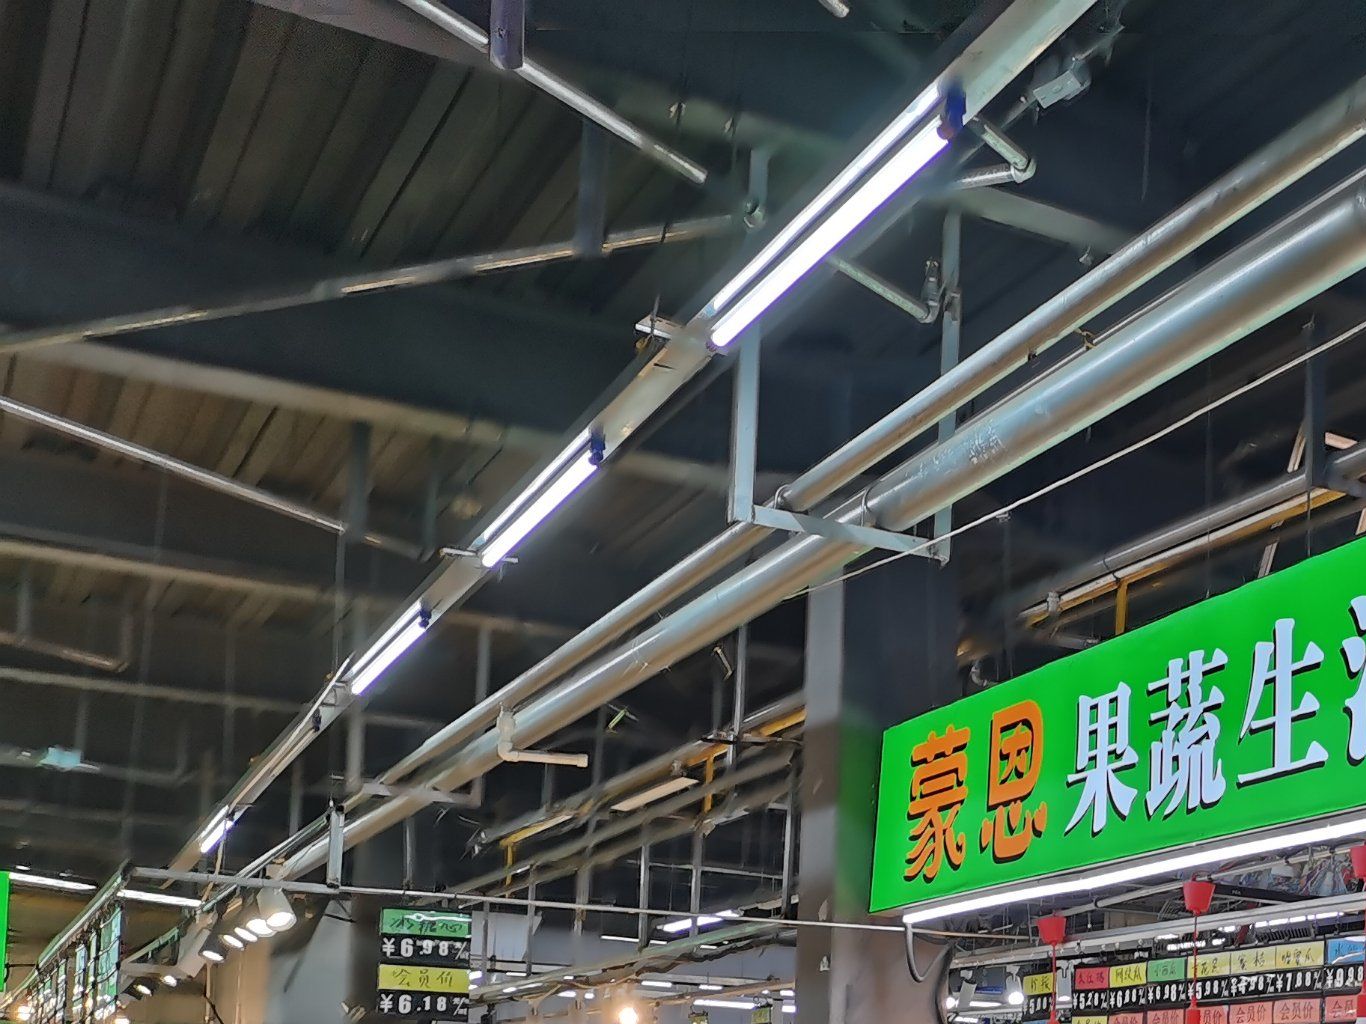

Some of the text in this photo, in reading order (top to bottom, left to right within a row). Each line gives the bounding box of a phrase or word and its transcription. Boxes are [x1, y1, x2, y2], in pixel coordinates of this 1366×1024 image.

[903, 699, 1049, 883] 蒙恩
[382, 938, 449, 957] ¥6.98
[393, 969, 453, 988] 会员价
[379, 994, 447, 1014] ¥6.18
[1280, 1002, 1313, 1020] 会员价
[1329, 1000, 1356, 1018] 会员
[1236, 1005, 1266, 1024] 会员价
